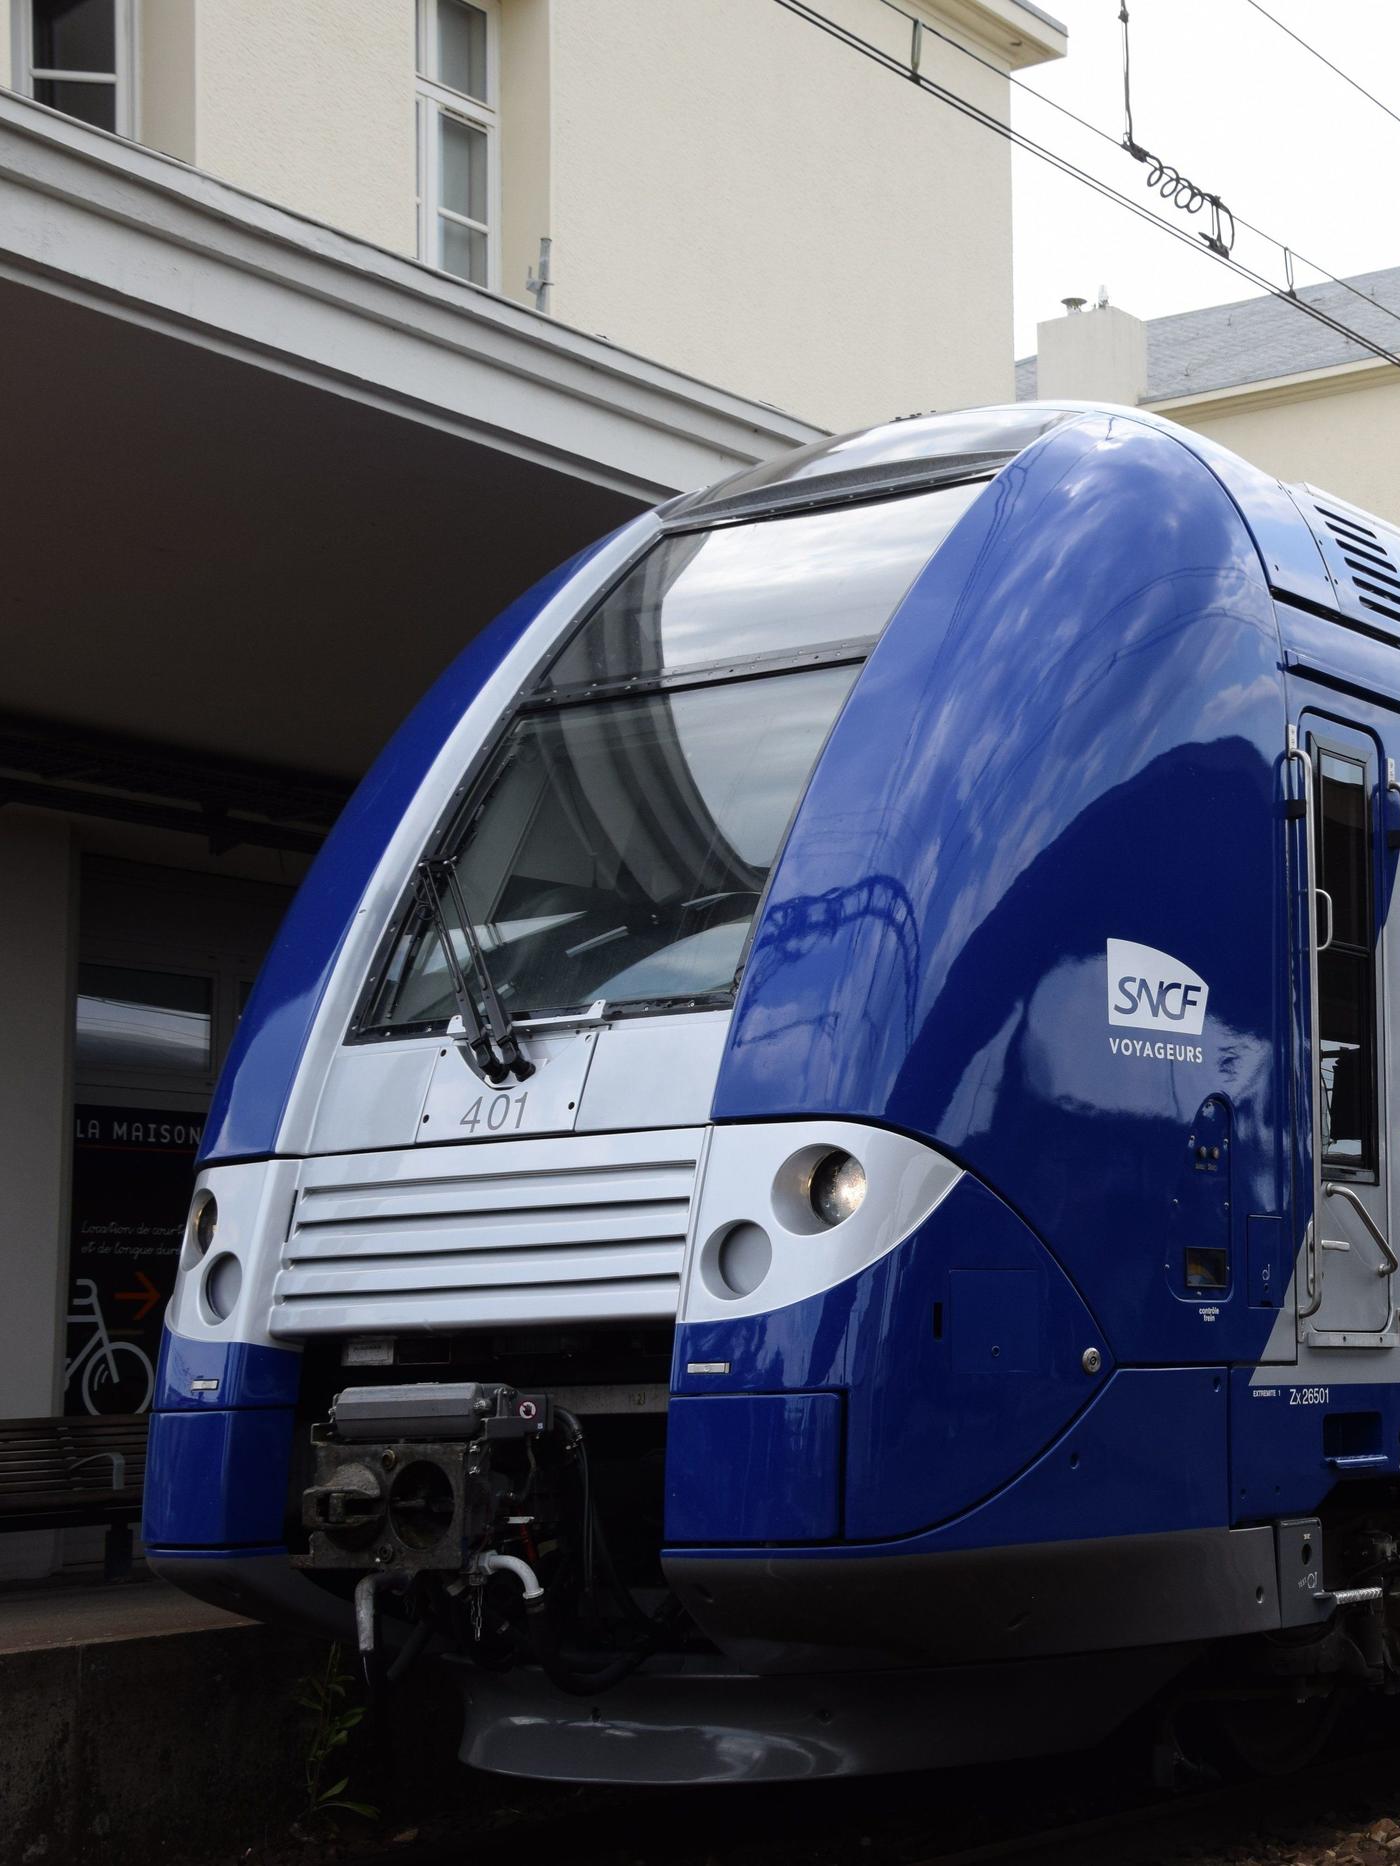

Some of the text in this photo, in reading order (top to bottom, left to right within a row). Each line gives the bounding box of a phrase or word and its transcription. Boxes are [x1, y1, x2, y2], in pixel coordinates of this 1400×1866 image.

[1113, 976, 1202, 1021] SNCF
[1109, 1037, 1203, 1063] VOYAGEURS
[460, 1091, 528, 1133] 401
[75, 1118, 201, 1146] LA MAISON
[81, 1218, 133, 1236] Location
[136, 1221, 150, 1236] de
[80, 1241, 97, 1254] et
[97, 1241, 112, 1254] de
[114, 1241, 154, 1260] longue
